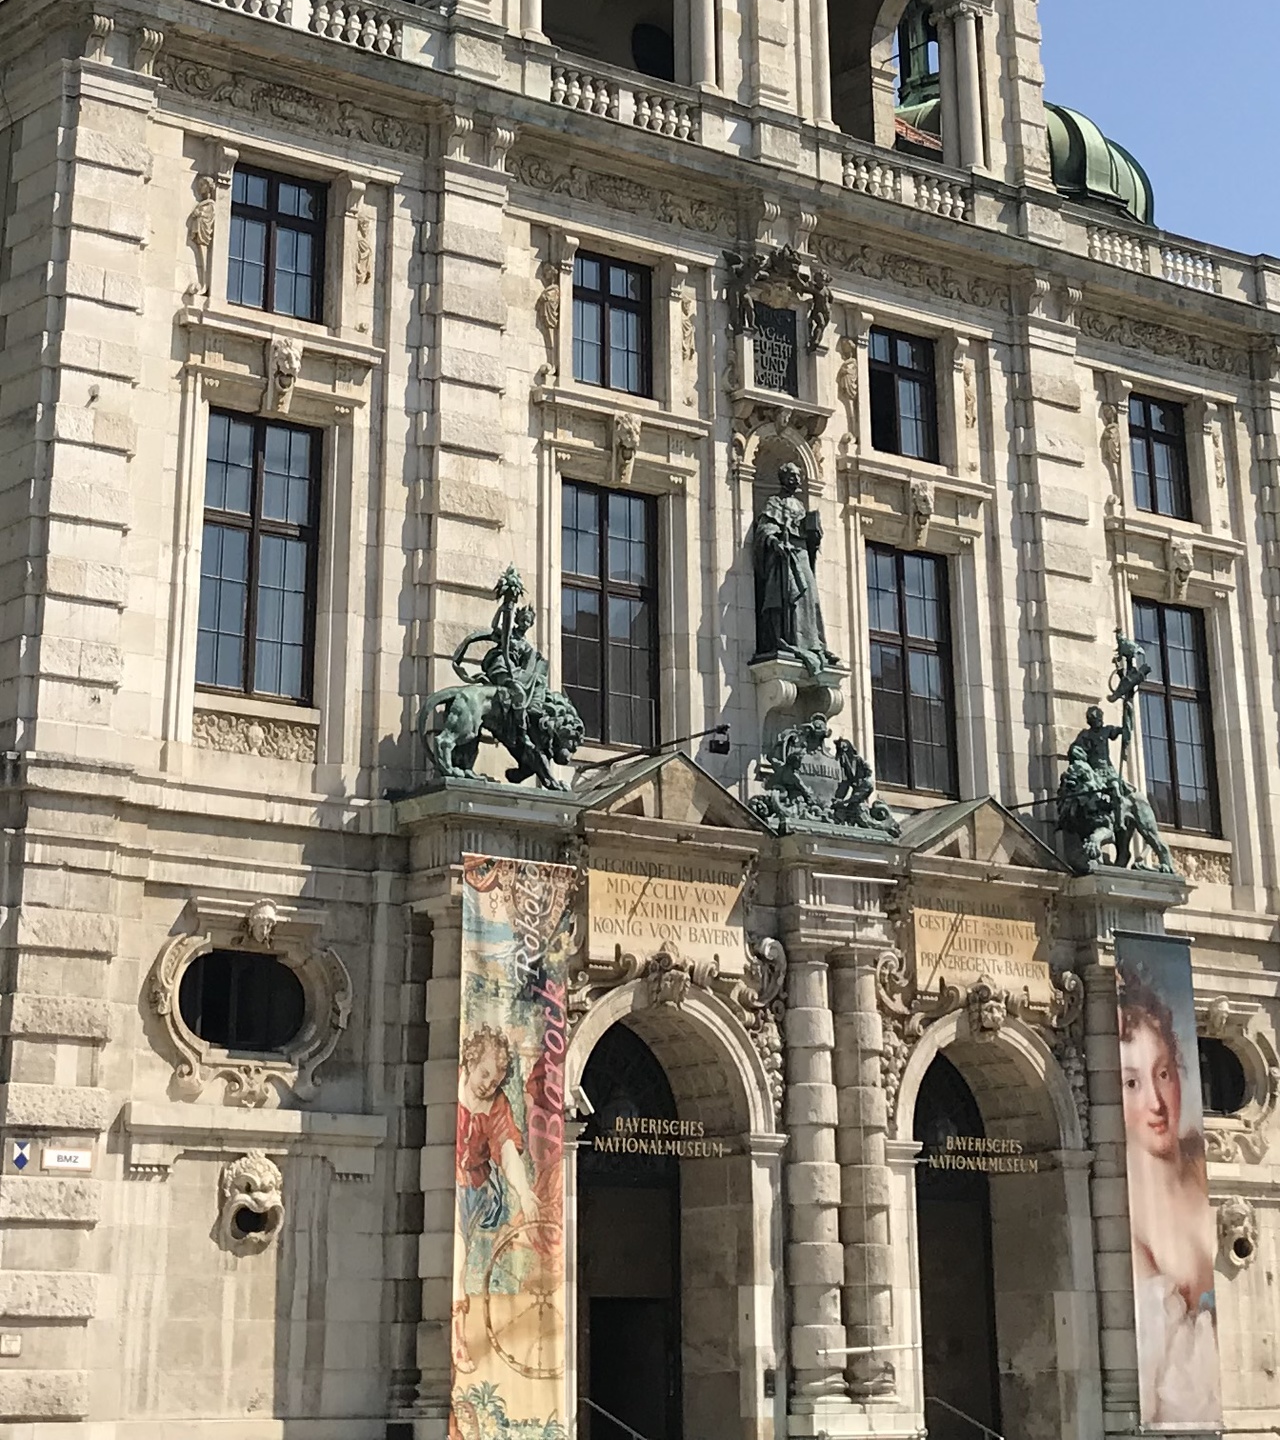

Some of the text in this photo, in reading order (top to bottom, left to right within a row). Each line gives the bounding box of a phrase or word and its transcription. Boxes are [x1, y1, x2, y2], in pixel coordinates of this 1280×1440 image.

[693, 887, 727, 906] VON
[614, 898, 709, 924] MAXIMILIAN
[514, 864, 548, 985] Rokoko
[649, 923, 682, 941] VON
[689, 927, 739, 947] BAYERN
[951, 937, 1014, 957] LUITPOLD
[1005, 962, 1046, 979] BAYERN
[527, 978, 567, 1157] Barock
[616, 1116, 704, 1137] BAYERISCHES
[594, 1136, 723, 1158] NATIONALMUSEUM
[946, 1136, 1023, 1154] BAYERISCHES
[57, 1155, 79, 1163] BMZ
[929, 1154, 1038, 1173] NATIONALMUSEUM
